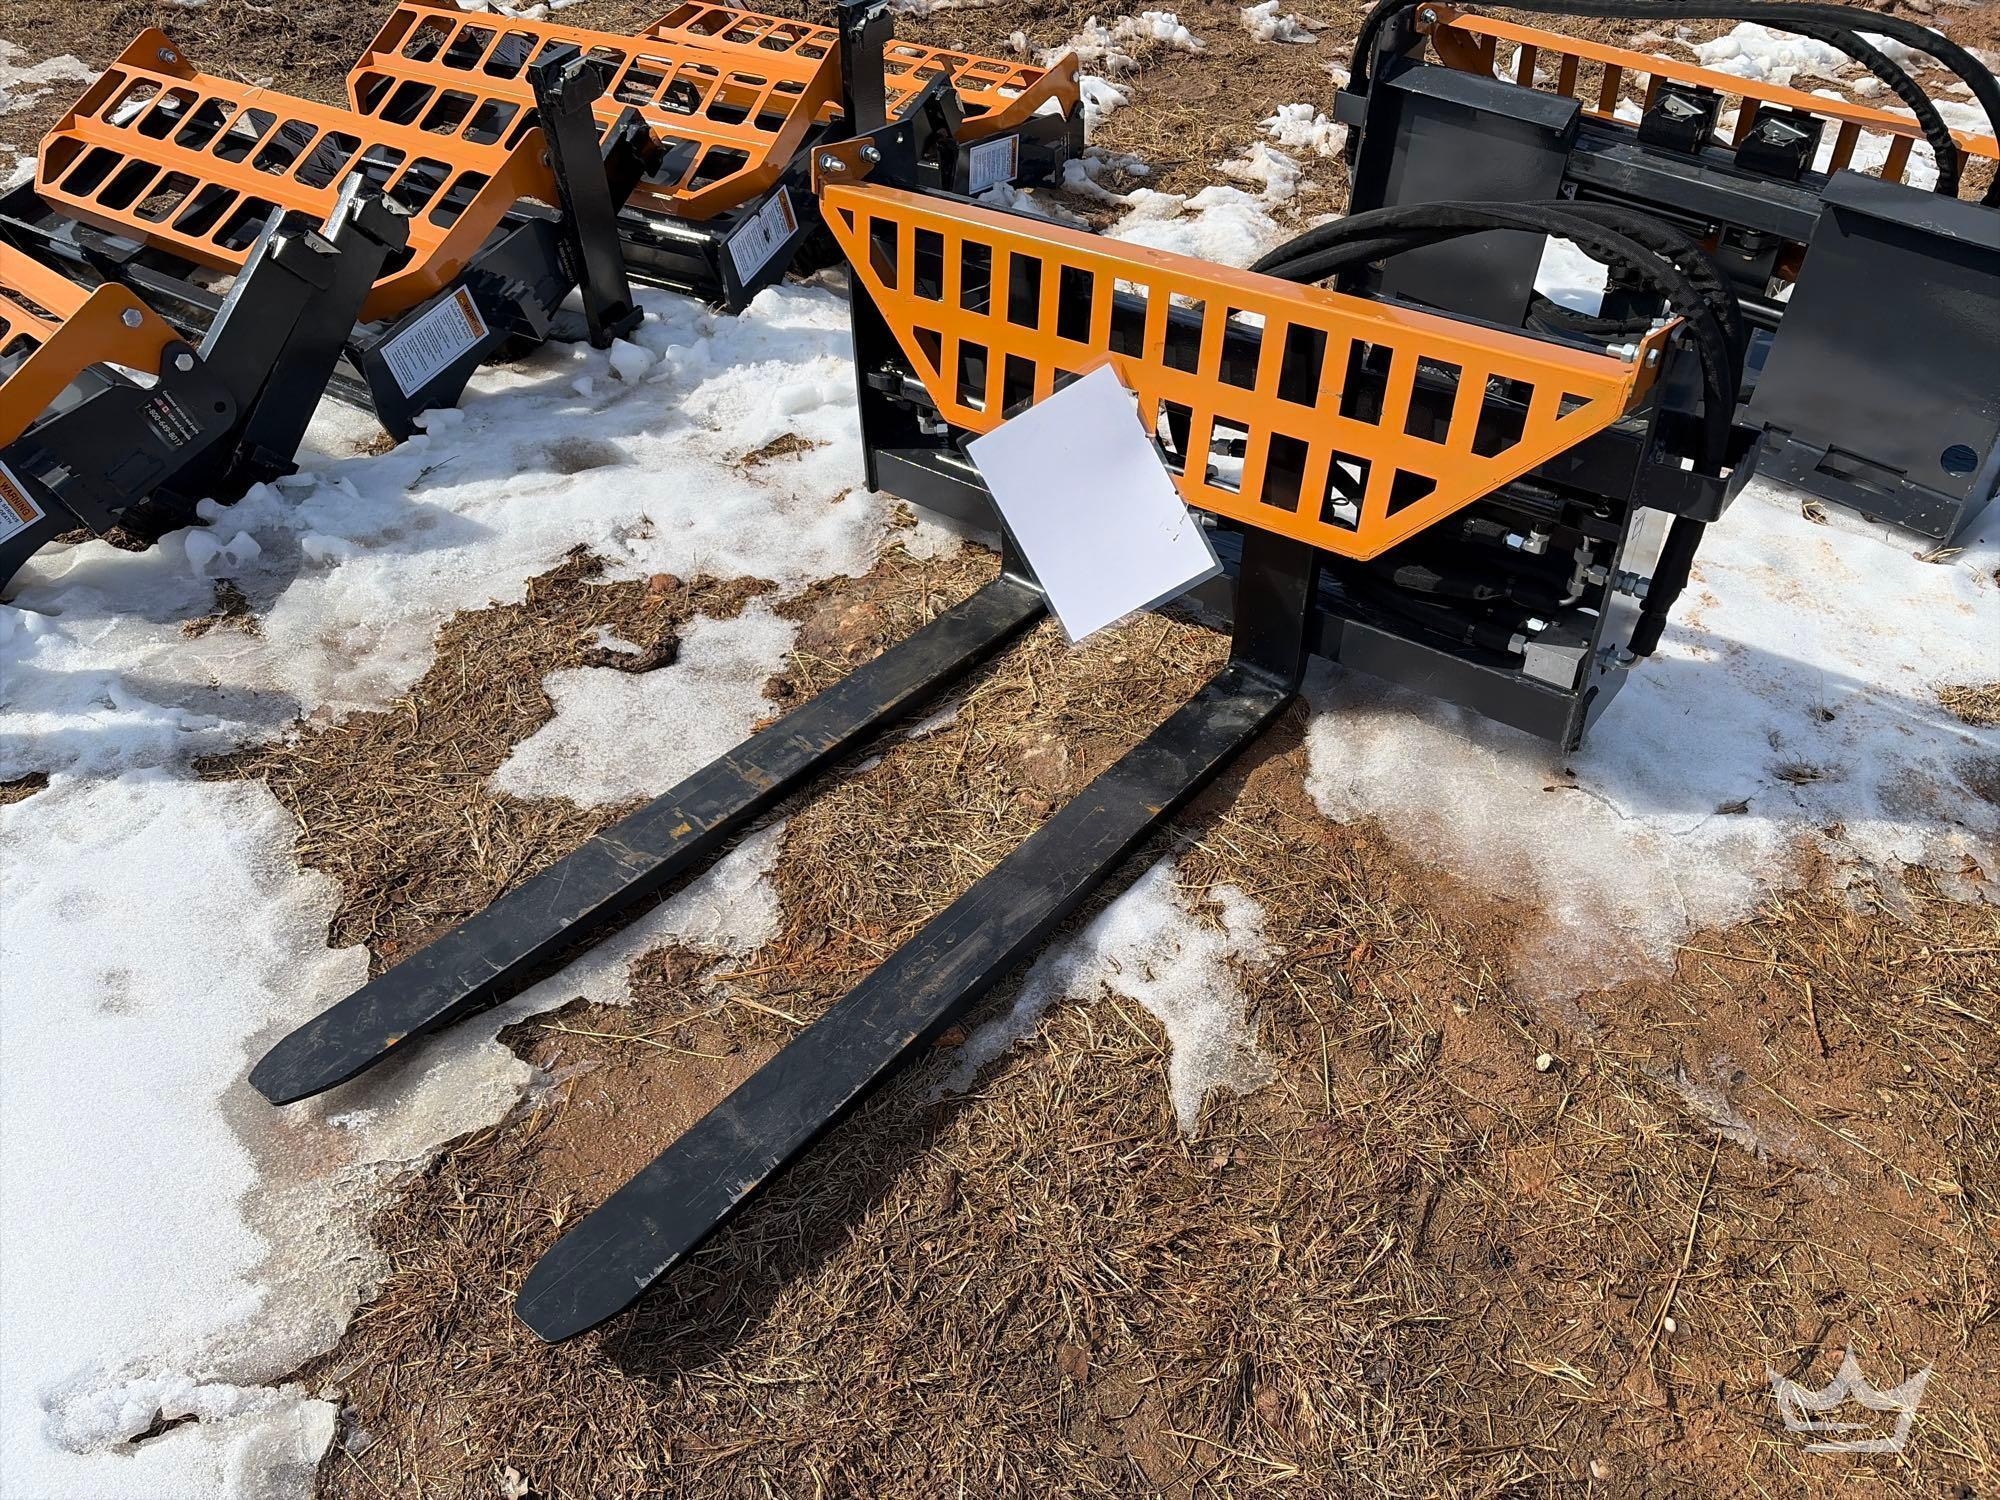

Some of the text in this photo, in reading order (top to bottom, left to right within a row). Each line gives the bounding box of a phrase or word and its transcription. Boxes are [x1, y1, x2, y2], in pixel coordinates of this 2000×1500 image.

[462, 302, 480, 332] WARNING
[145, 404, 183, 446] 1-800-649-8017
[1, 482, 30, 516] WARNING
[2, 504, 19, 522] SERIOUS
